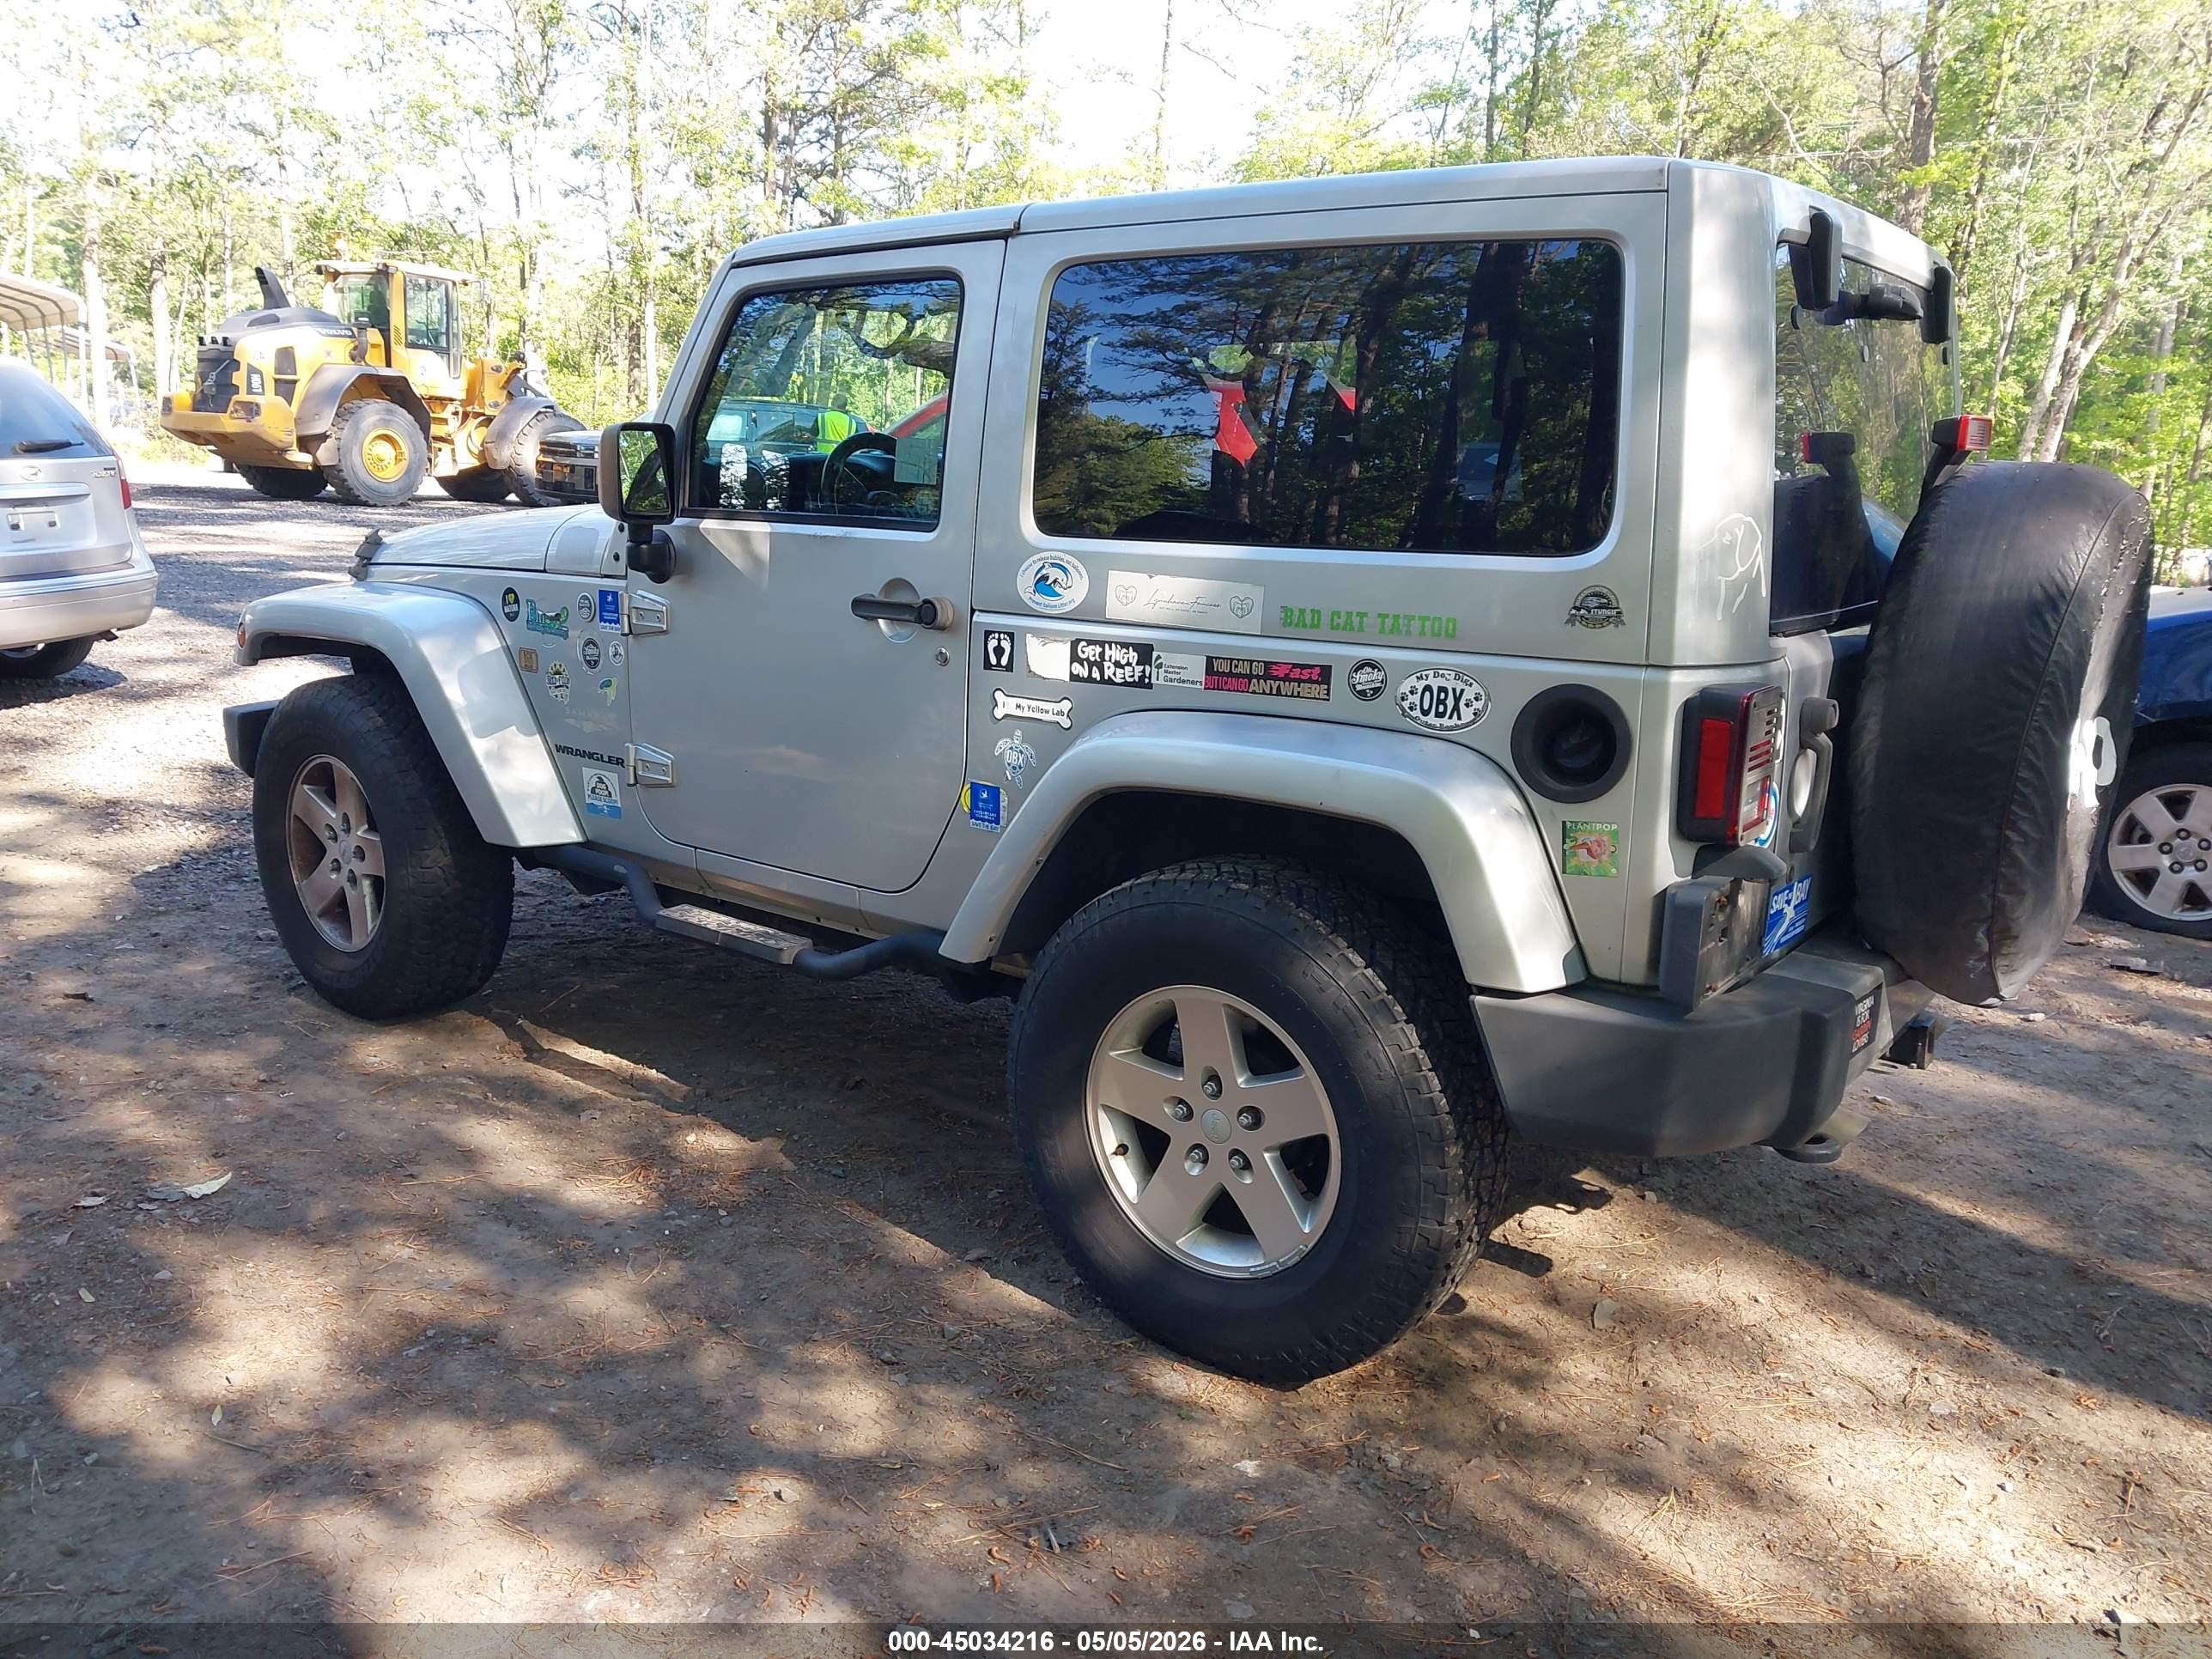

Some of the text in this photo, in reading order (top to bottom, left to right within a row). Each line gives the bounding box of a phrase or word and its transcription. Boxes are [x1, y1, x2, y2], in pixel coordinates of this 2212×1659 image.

[250, 373, 263, 393] L90H
[1280, 605, 1457, 638] BAD CAT TATTOO
[1071, 660, 1152, 684] ON A REEF!
[1212, 658, 1231, 673] YOU
[1231, 659, 1250, 675] CAN
[1251, 661, 1265, 676] GO
[1351, 667, 1385, 684] Smoky
[1163, 675, 1203, 687] Gardeners
[1205, 675, 1218, 690] BUT
[1222, 677, 1238, 690] CAN
[1237, 678, 1249, 691] GO
[1249, 678, 1330, 700] ANYWHERE
[1415, 671, 1474, 688] My Dog Digs
[1015, 702, 1025, 714] My
[1026, 704, 1050, 715] Yellow
[1051, 707, 1066, 718] Lab
[1419, 684, 1467, 721] OBX
[555, 743, 626, 769] WRANGLER
[1006, 749, 1024, 764] OBX
[1566, 820, 1618, 831] PLANTPOP
[1770, 889, 1790, 915] SAVE
[1796, 877, 1813, 904] BAY
